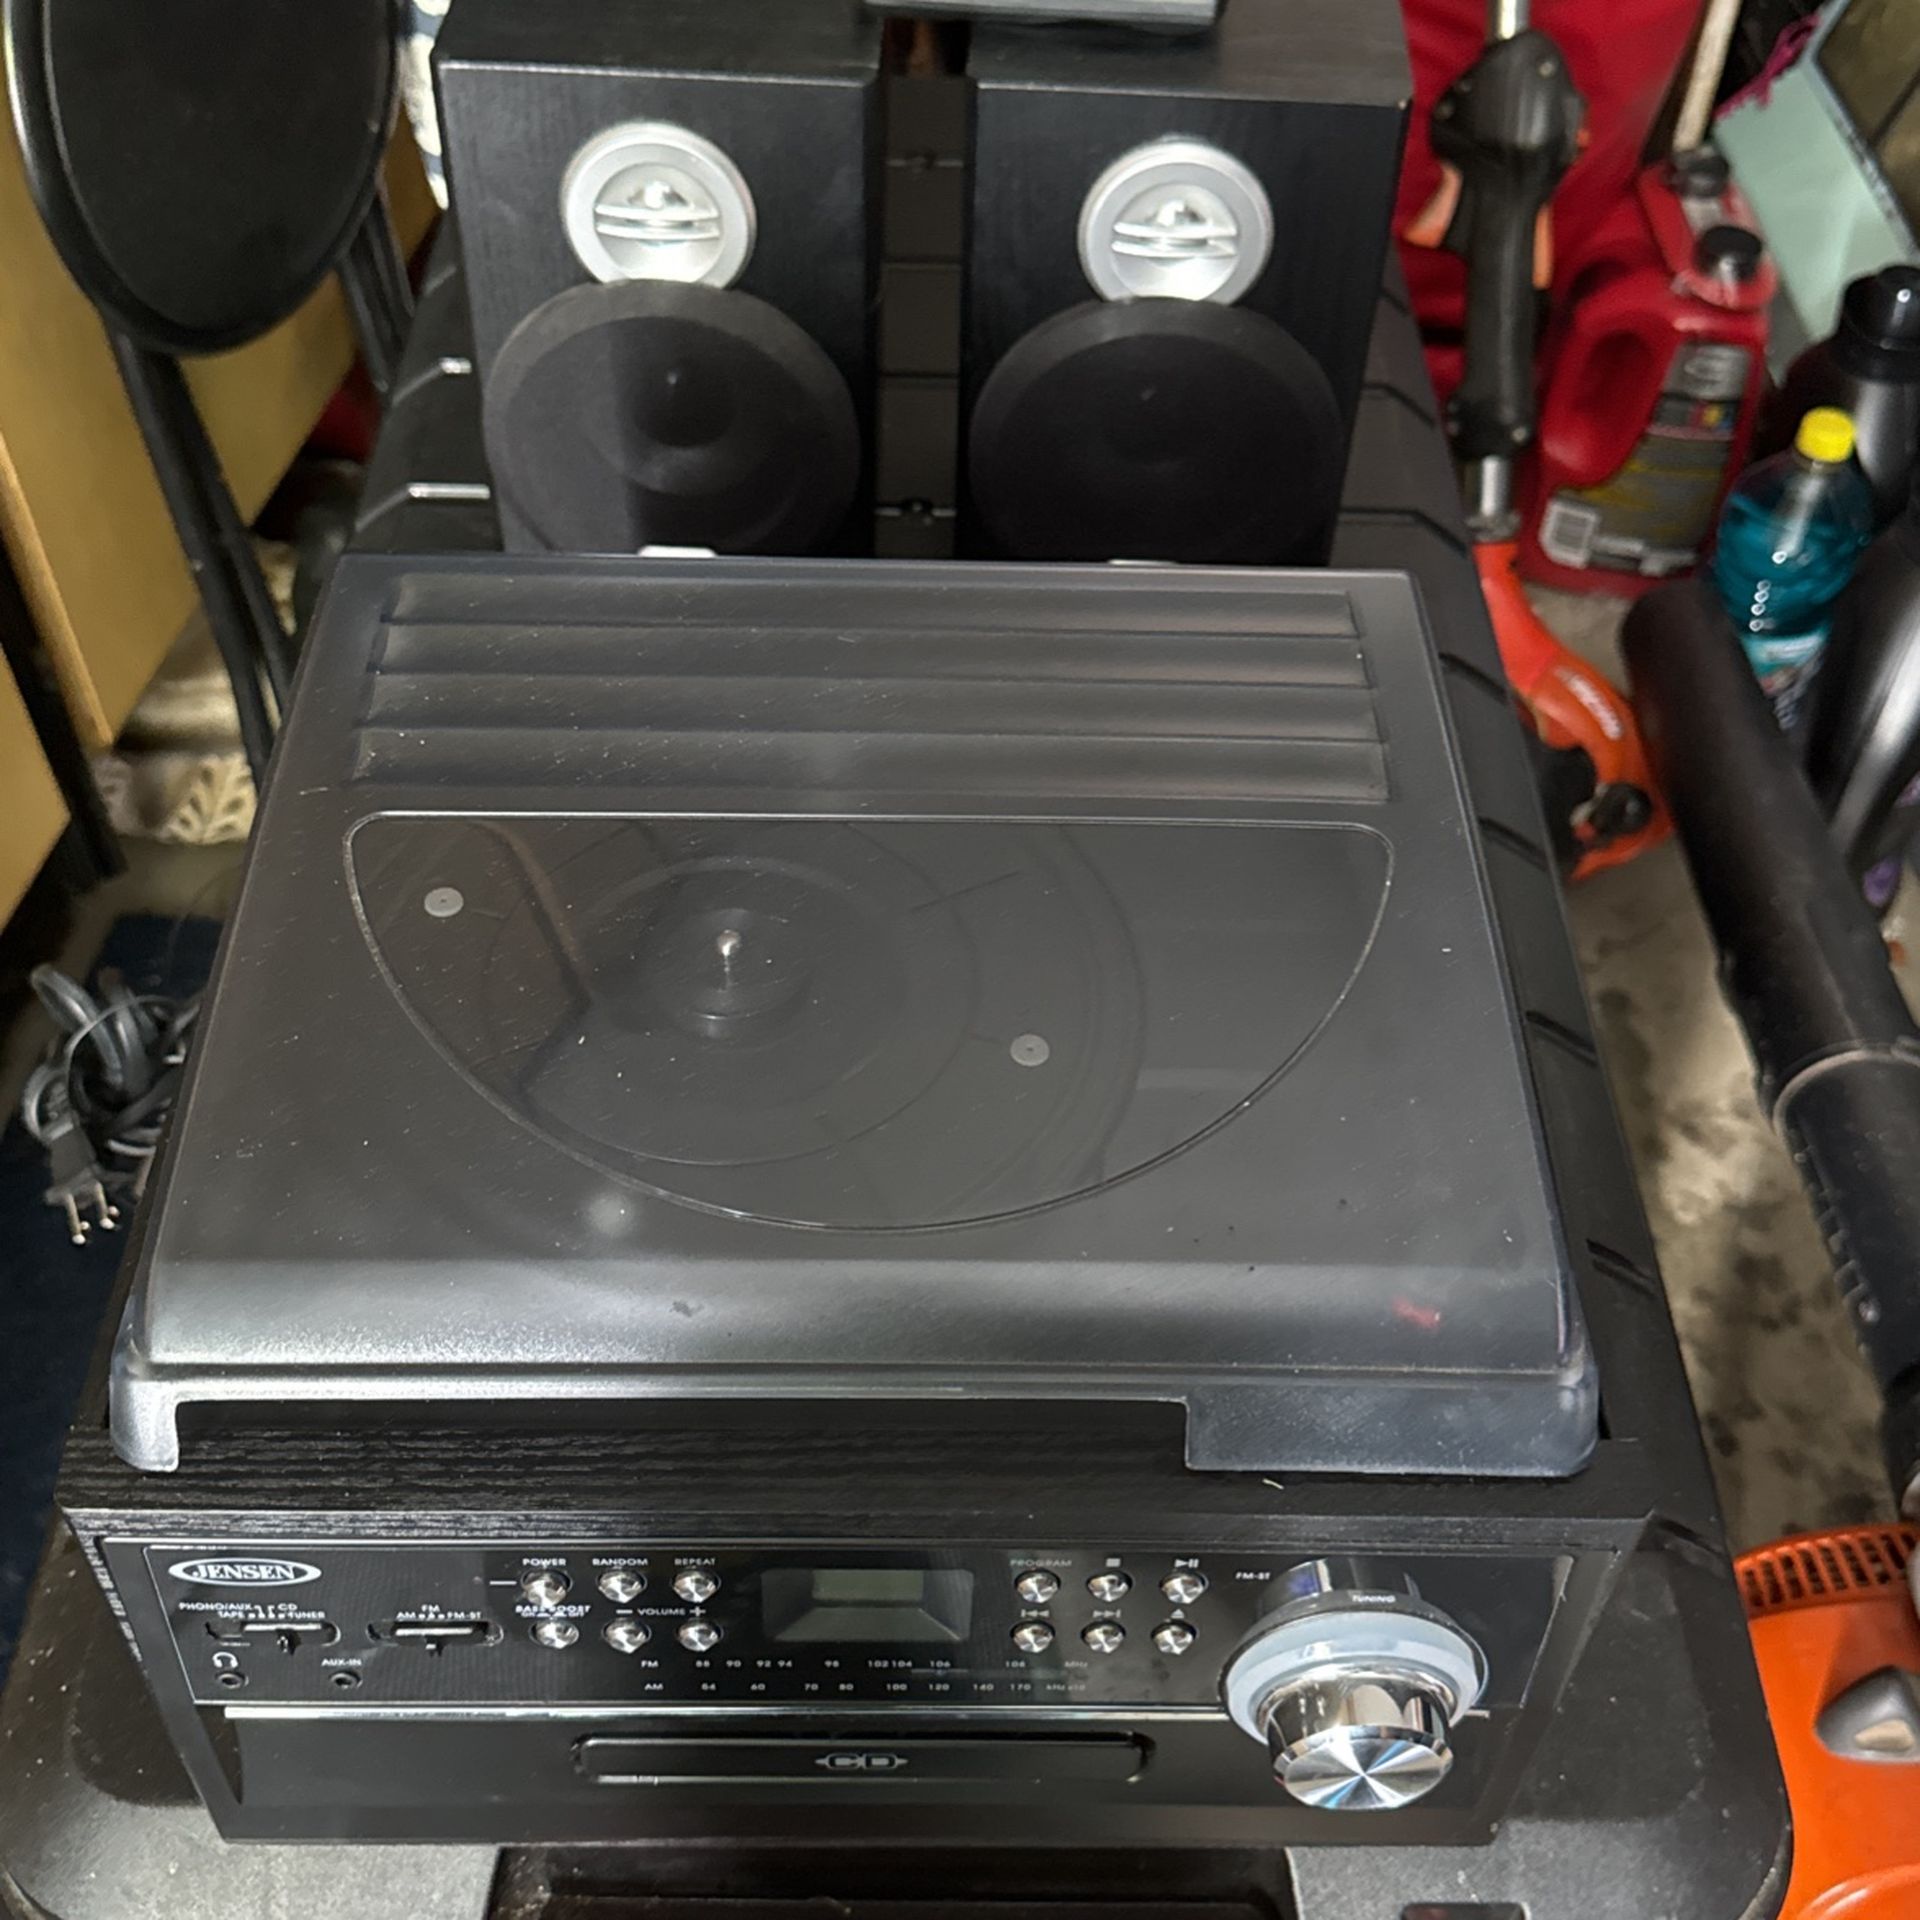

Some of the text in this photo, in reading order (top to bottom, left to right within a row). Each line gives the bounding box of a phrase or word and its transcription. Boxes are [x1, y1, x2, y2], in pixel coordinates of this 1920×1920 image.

[522, 1558, 567, 1567] POWER
[592, 1558, 648, 1566] RANDOM
[674, 1558, 716, 1566] REPEAT
[1010, 1558, 1072, 1567] PROGRAM
[192, 1563, 296, 1580] JENSEN
[178, 1602, 252, 1611] PHONO/AUX
[277, 1603, 298, 1611] CD
[421, 1604, 441, 1612] FM
[217, 1611, 246, 1619] TAPE
[396, 1611, 416, 1619] AM
[638, 1607, 686, 1616] VOLUME
[321, 1658, 362, 1667] AUX-IN
[641, 1660, 659, 1668] FM
[726, 1660, 742, 1668] 90
[756, 1660, 772, 1668] 92
[778, 1660, 793, 1668] 94
[868, 1660, 889, 1668] 102
[892, 1660, 912, 1668] 104
[930, 1660, 951, 1668] 106
[644, 1683, 664, 1691] AM
[750, 1683, 766, 1691] 60
[804, 1683, 819, 1691] 70
[886, 1683, 908, 1691] 100
[929, 1683, 950, 1691] 120
